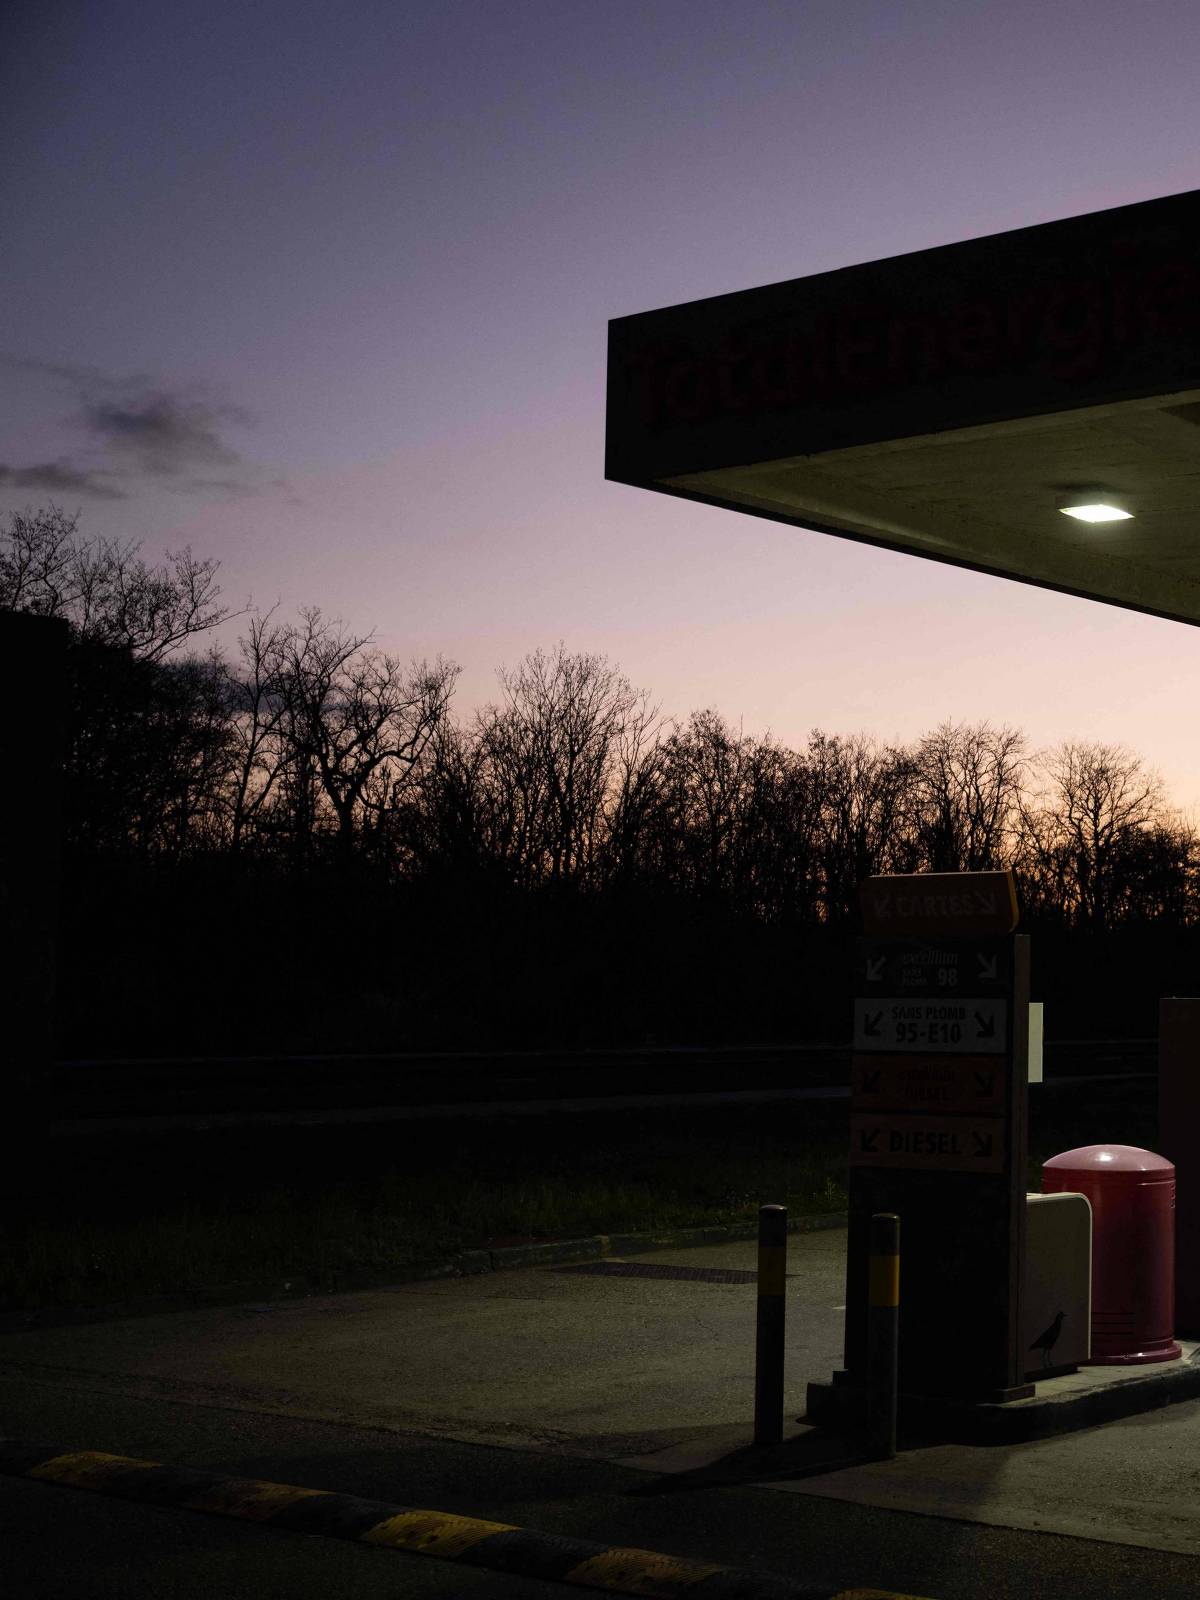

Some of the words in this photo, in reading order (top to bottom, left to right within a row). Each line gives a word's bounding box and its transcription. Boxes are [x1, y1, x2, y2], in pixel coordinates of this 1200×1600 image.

[897, 894, 976, 917] CARTES
[937, 967, 959, 987] 98
[891, 1007, 922, 1020] SANS
[926, 1007, 966, 1020] PLOMB
[895, 1023, 962, 1043] 95-E10
[889, 1131, 961, 1154] DIESEL
